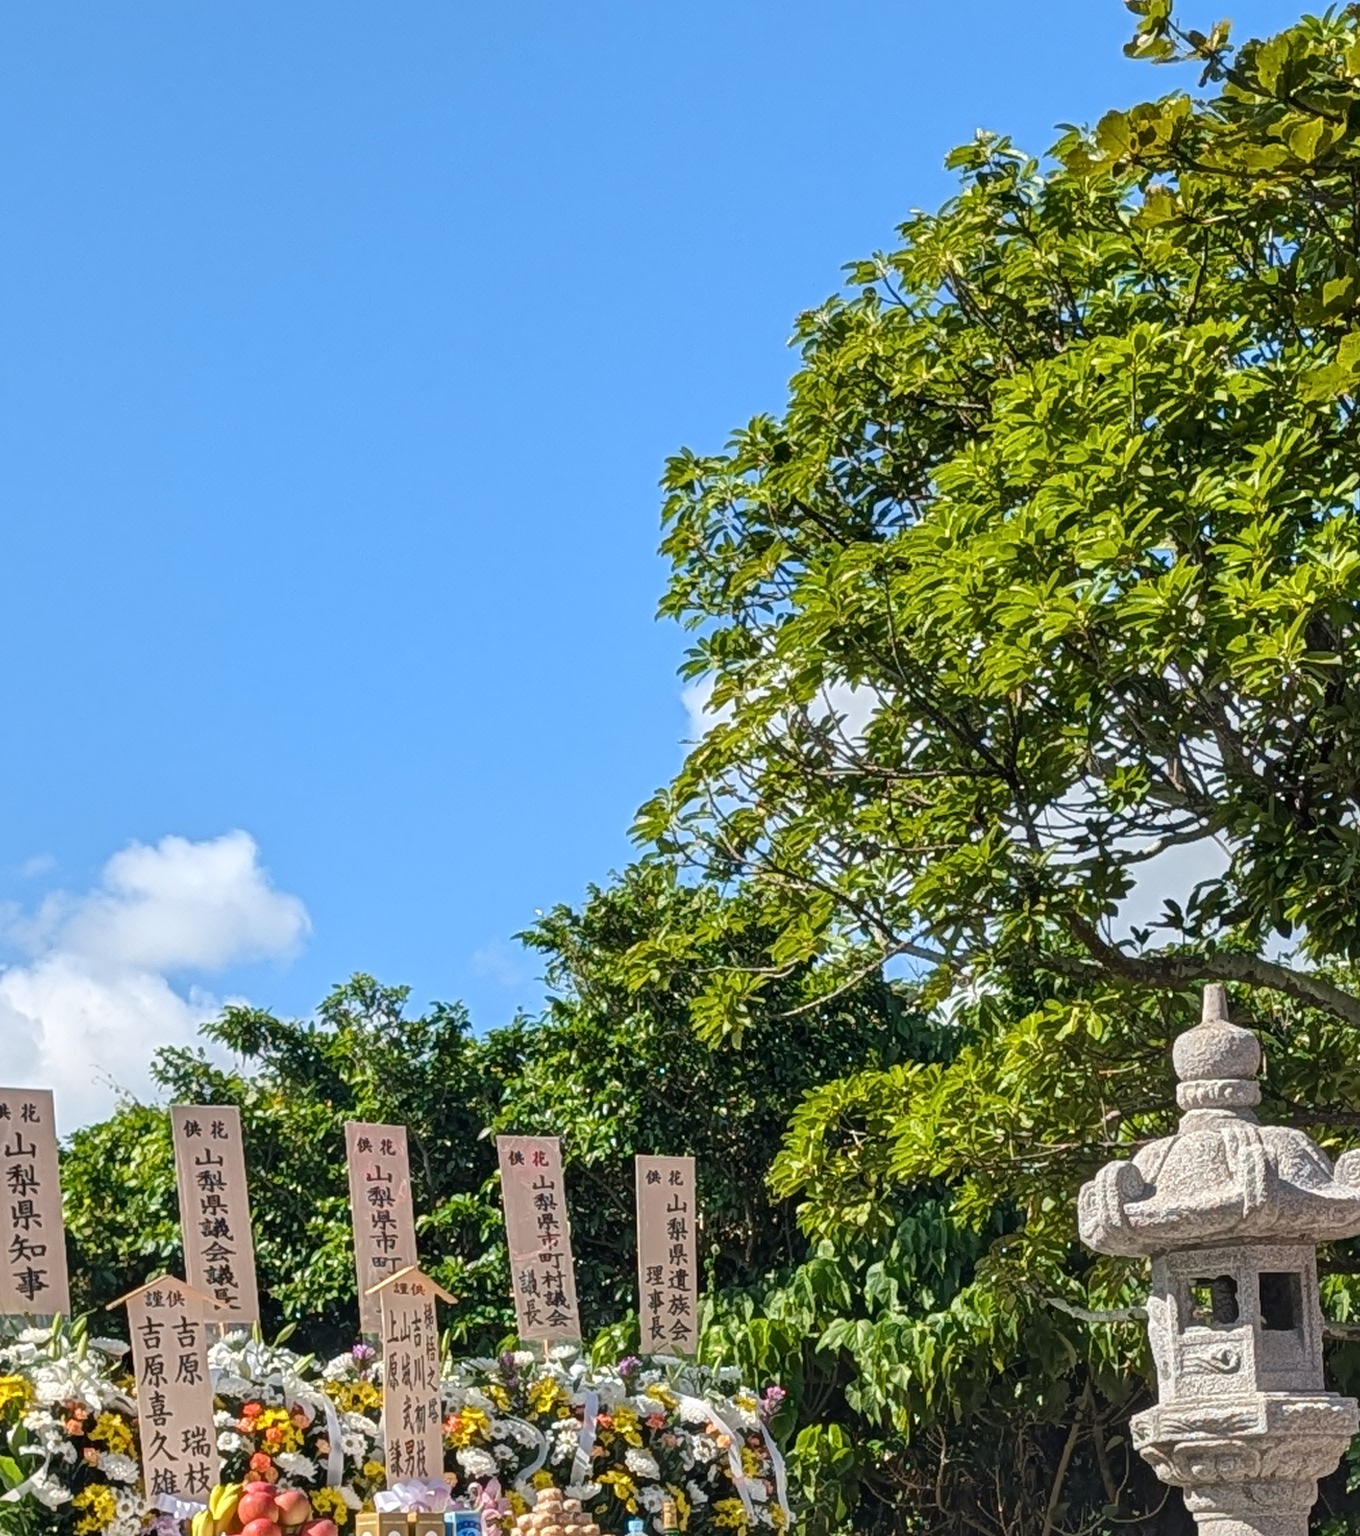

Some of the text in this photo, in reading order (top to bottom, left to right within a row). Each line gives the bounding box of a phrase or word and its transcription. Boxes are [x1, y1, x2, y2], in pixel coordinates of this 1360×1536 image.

[183, 1119, 229, 1140] 供花
[356, 1137, 397, 1156] 供花
[509, 1149, 550, 1168] 供花
[646, 1168, 684, 1187] 供花
[4, 1131, 53, 1302] 山梨県知事
[195, 1148, 242, 1312] 山梨県議会議長
[531, 1175, 574, 1328] 山梨県市町村議会
[666, 1194, 692, 1343] 山梨県遺族会
[143, 1289, 186, 1310] 謹供
[393, 1282, 426, 1297] 謹供
[518, 1270, 546, 1326] 議長
[645, 1265, 668, 1340] 理事長
[137, 1316, 181, 1498] 吉原喜久雄
[411, 1309, 428, 1478] 吉川初枝
